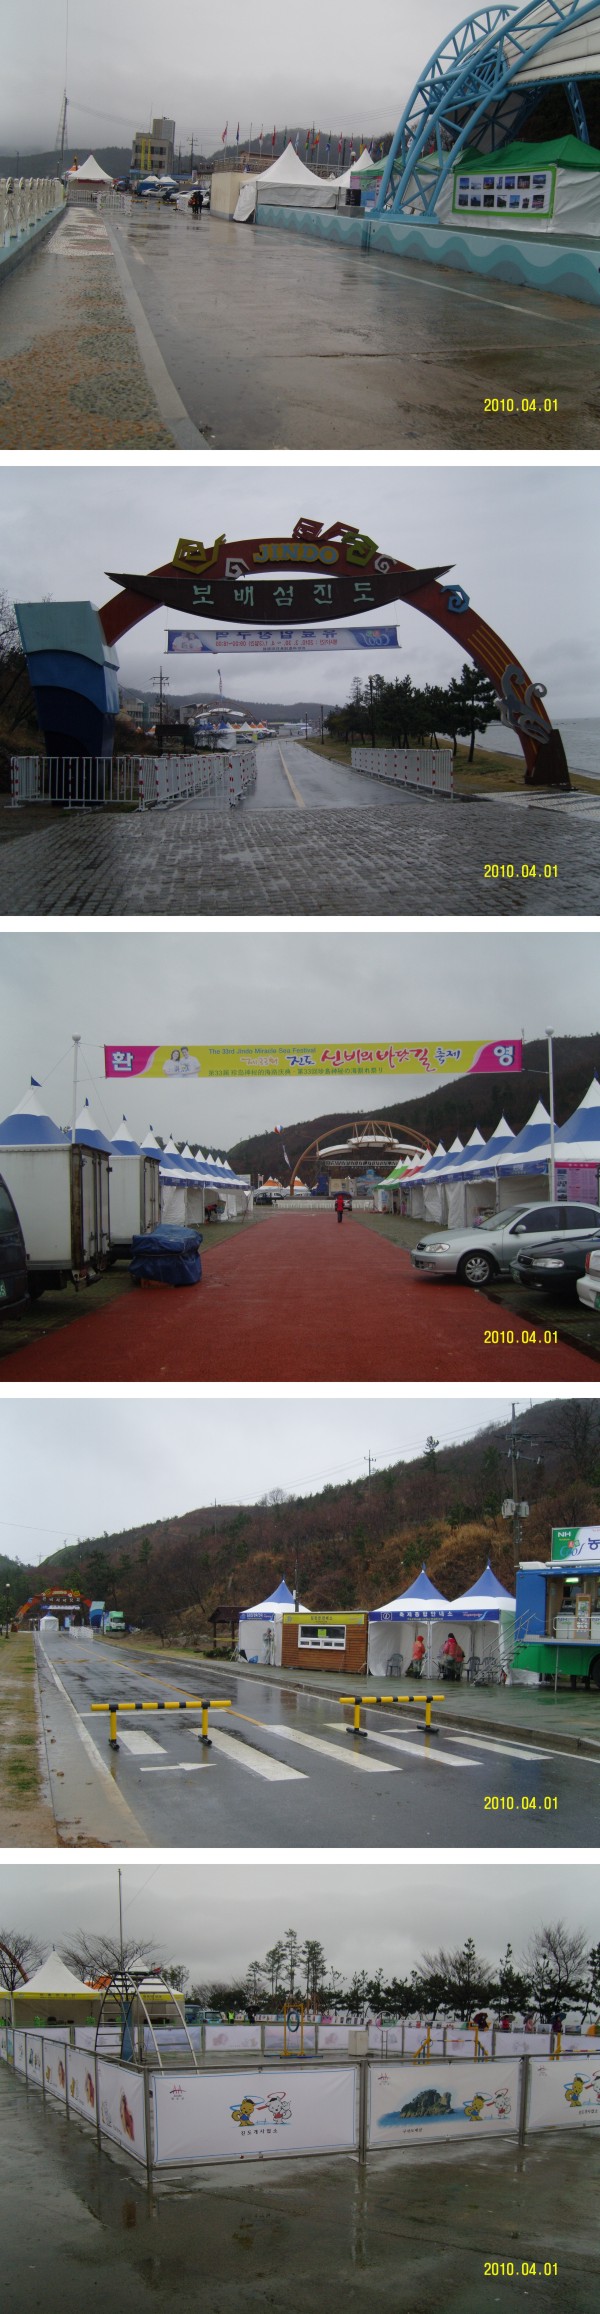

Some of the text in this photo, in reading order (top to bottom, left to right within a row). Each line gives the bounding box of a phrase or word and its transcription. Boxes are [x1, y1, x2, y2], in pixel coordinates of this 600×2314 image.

[253, 543, 339, 565] JINDO
[112, 1051, 134, 1072] 환
[286, 1055, 316, 1066] 진도
[435, 1047, 461, 1065] 축제
[493, 1045, 515, 1067] 영
